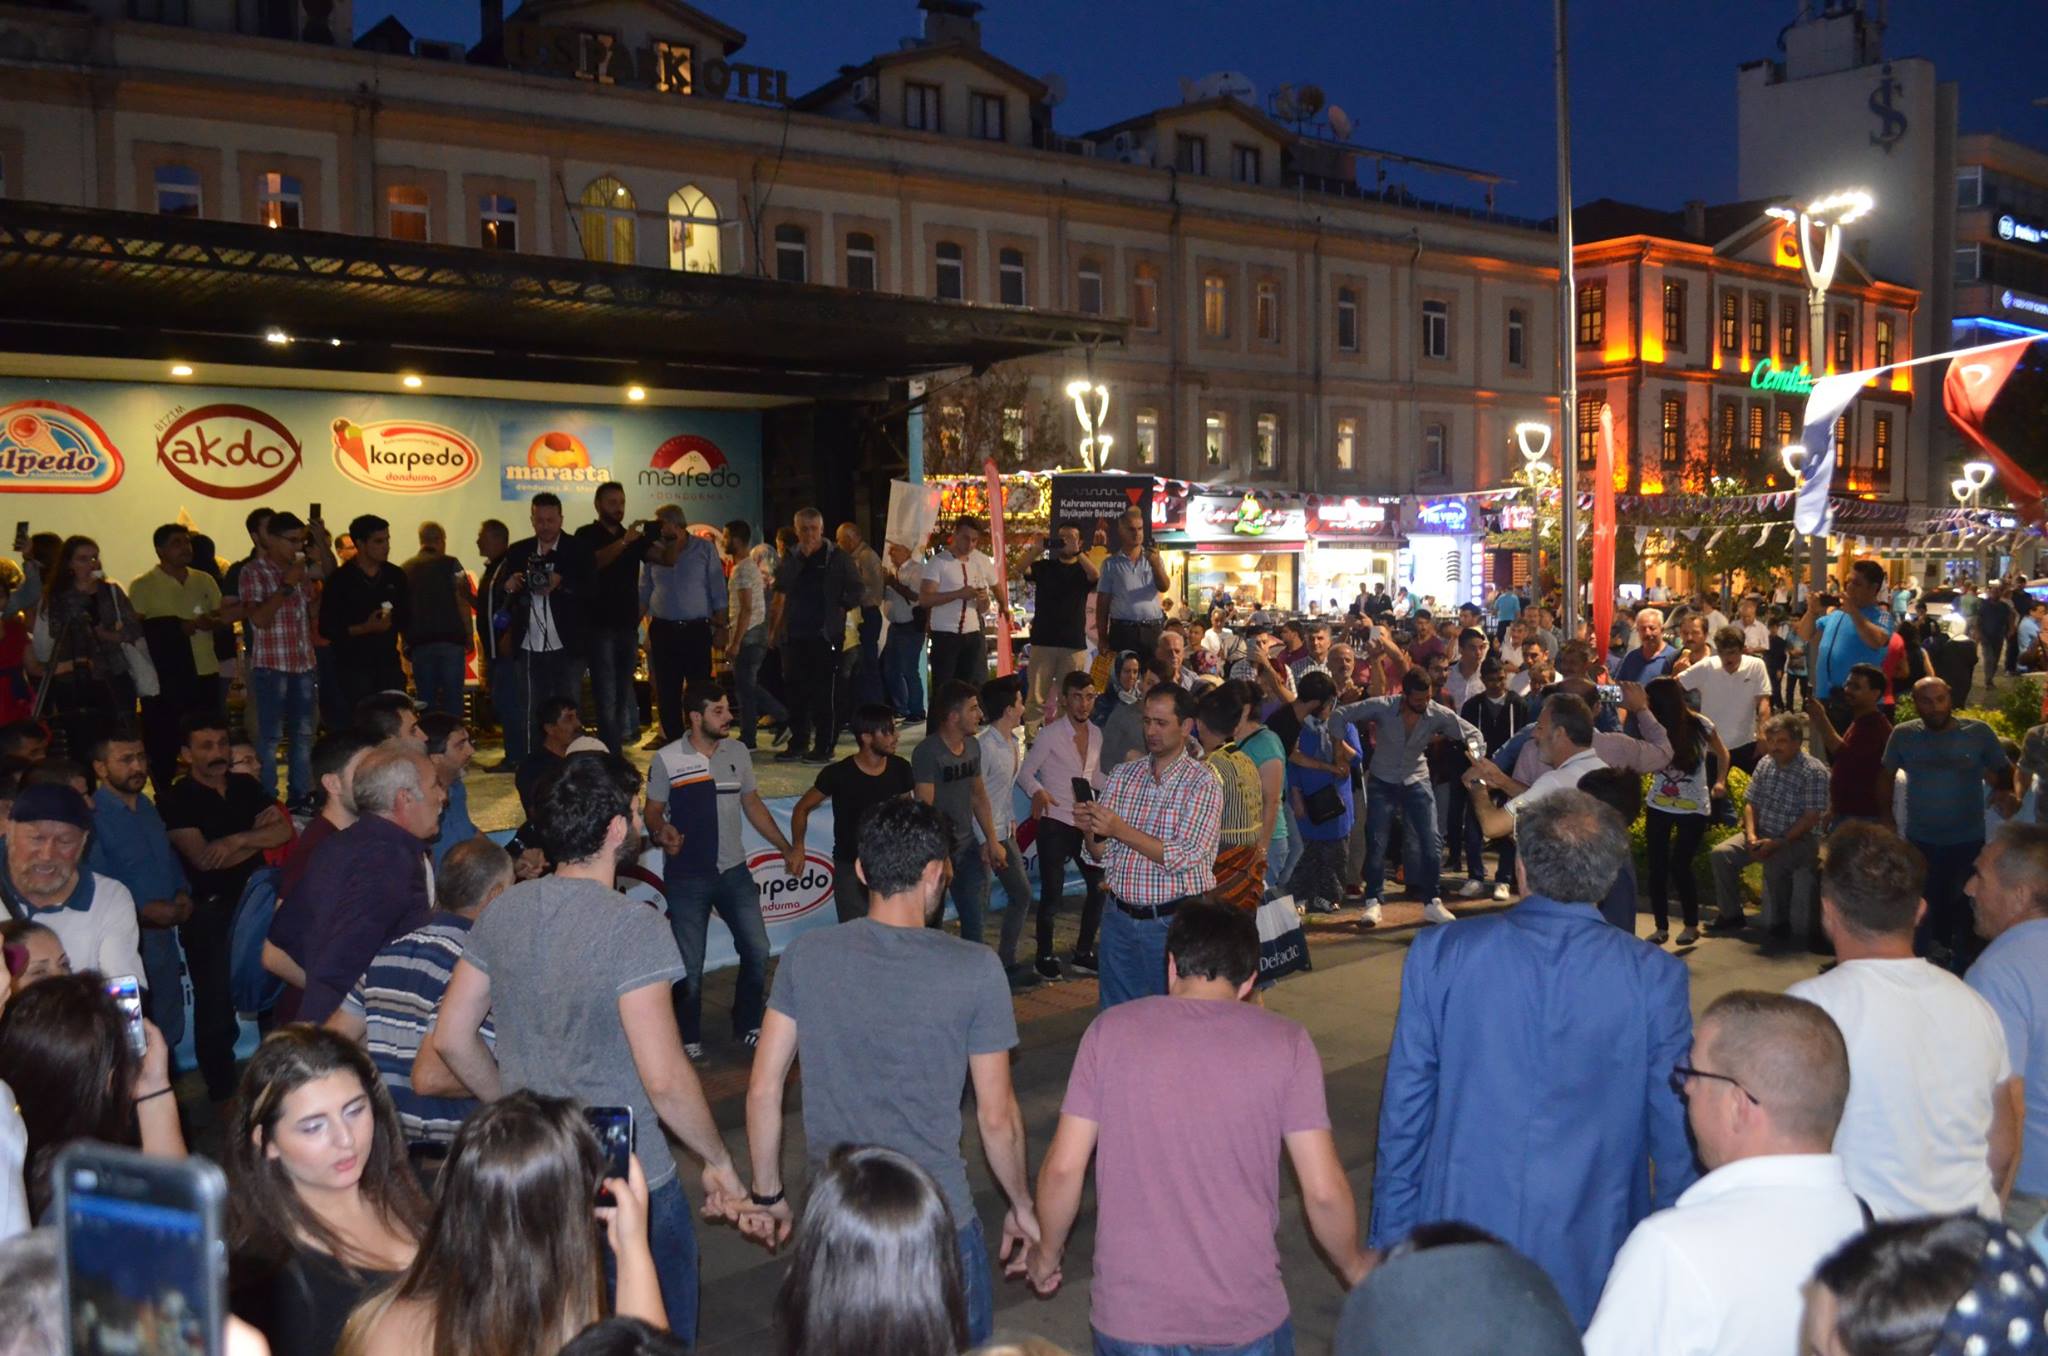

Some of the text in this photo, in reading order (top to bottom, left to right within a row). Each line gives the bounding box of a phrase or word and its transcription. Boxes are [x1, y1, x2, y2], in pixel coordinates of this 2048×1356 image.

[172, 425, 285, 468] akdo
[370, 444, 465, 471] karpedo
[385, 472, 438, 482] dondurma
[506, 465, 610, 482] marasta
[638, 466, 741, 488] marfedo
[1060, 499, 1127, 512] Kahramanmaraş
[761, 901, 800, 912] ndurma
